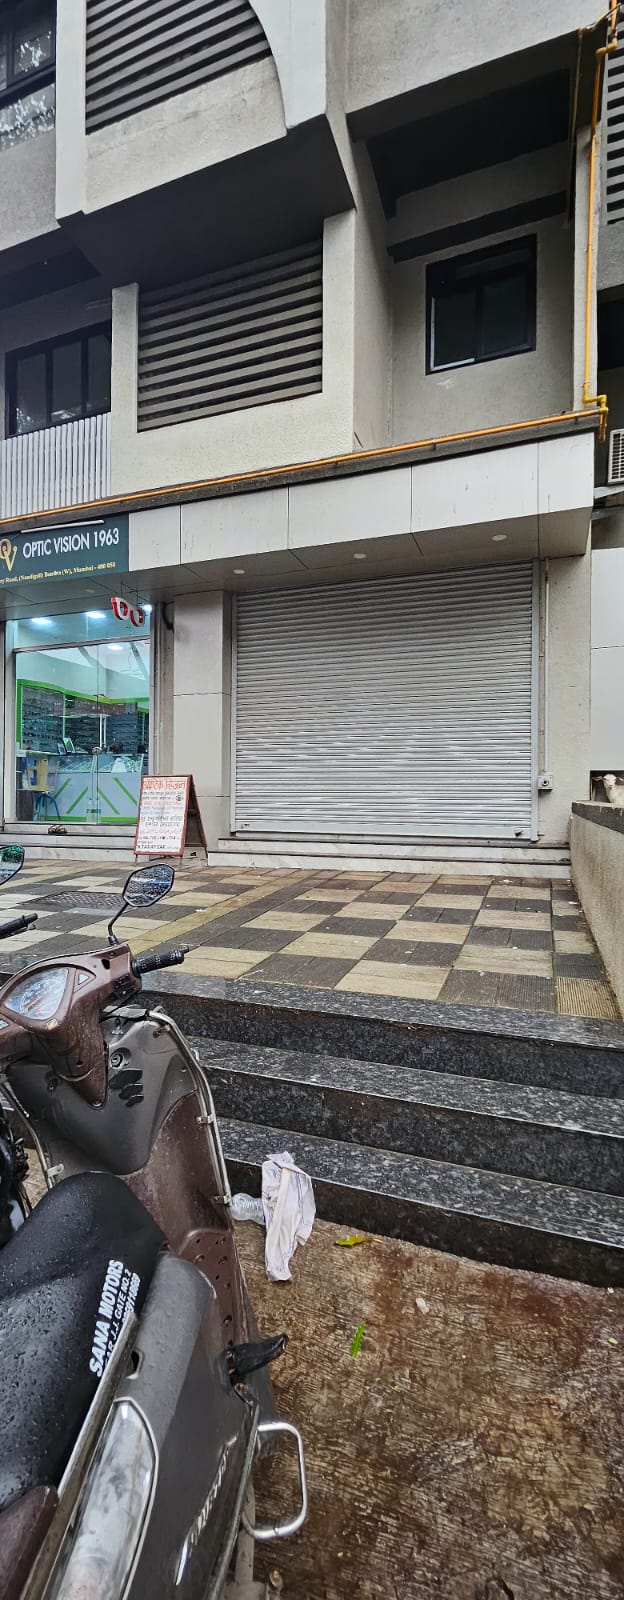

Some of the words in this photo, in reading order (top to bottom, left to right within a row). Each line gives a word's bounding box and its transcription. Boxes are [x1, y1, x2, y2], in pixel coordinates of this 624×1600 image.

[22, 537, 52, 559] OPTIC
[53, 532, 90, 554] VISION
[93, 527, 120, 548] 1963
[73, 564, 94, 573] Mumbai
[98, 1259, 124, 1319] MOTORS
[114, 1290, 127, 1320] GATE
[89, 1320, 111, 1378] SANA
